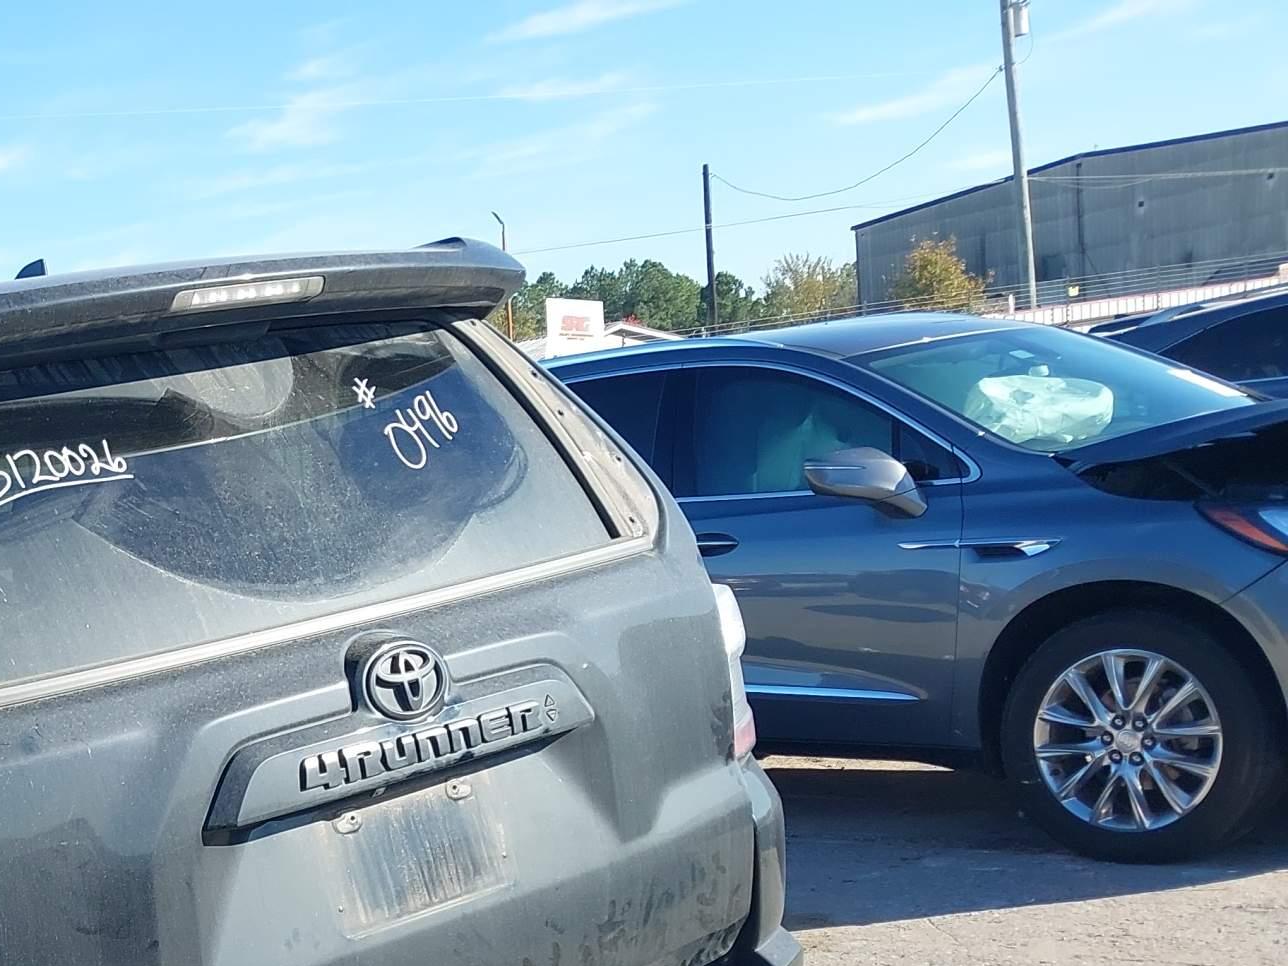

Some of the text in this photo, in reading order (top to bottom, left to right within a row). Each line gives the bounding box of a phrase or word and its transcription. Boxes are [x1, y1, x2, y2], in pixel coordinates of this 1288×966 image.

[351, 376, 377, 409] #
[383, 389, 459, 470] 0496
[298, 700, 543, 793] 4RUNNER
